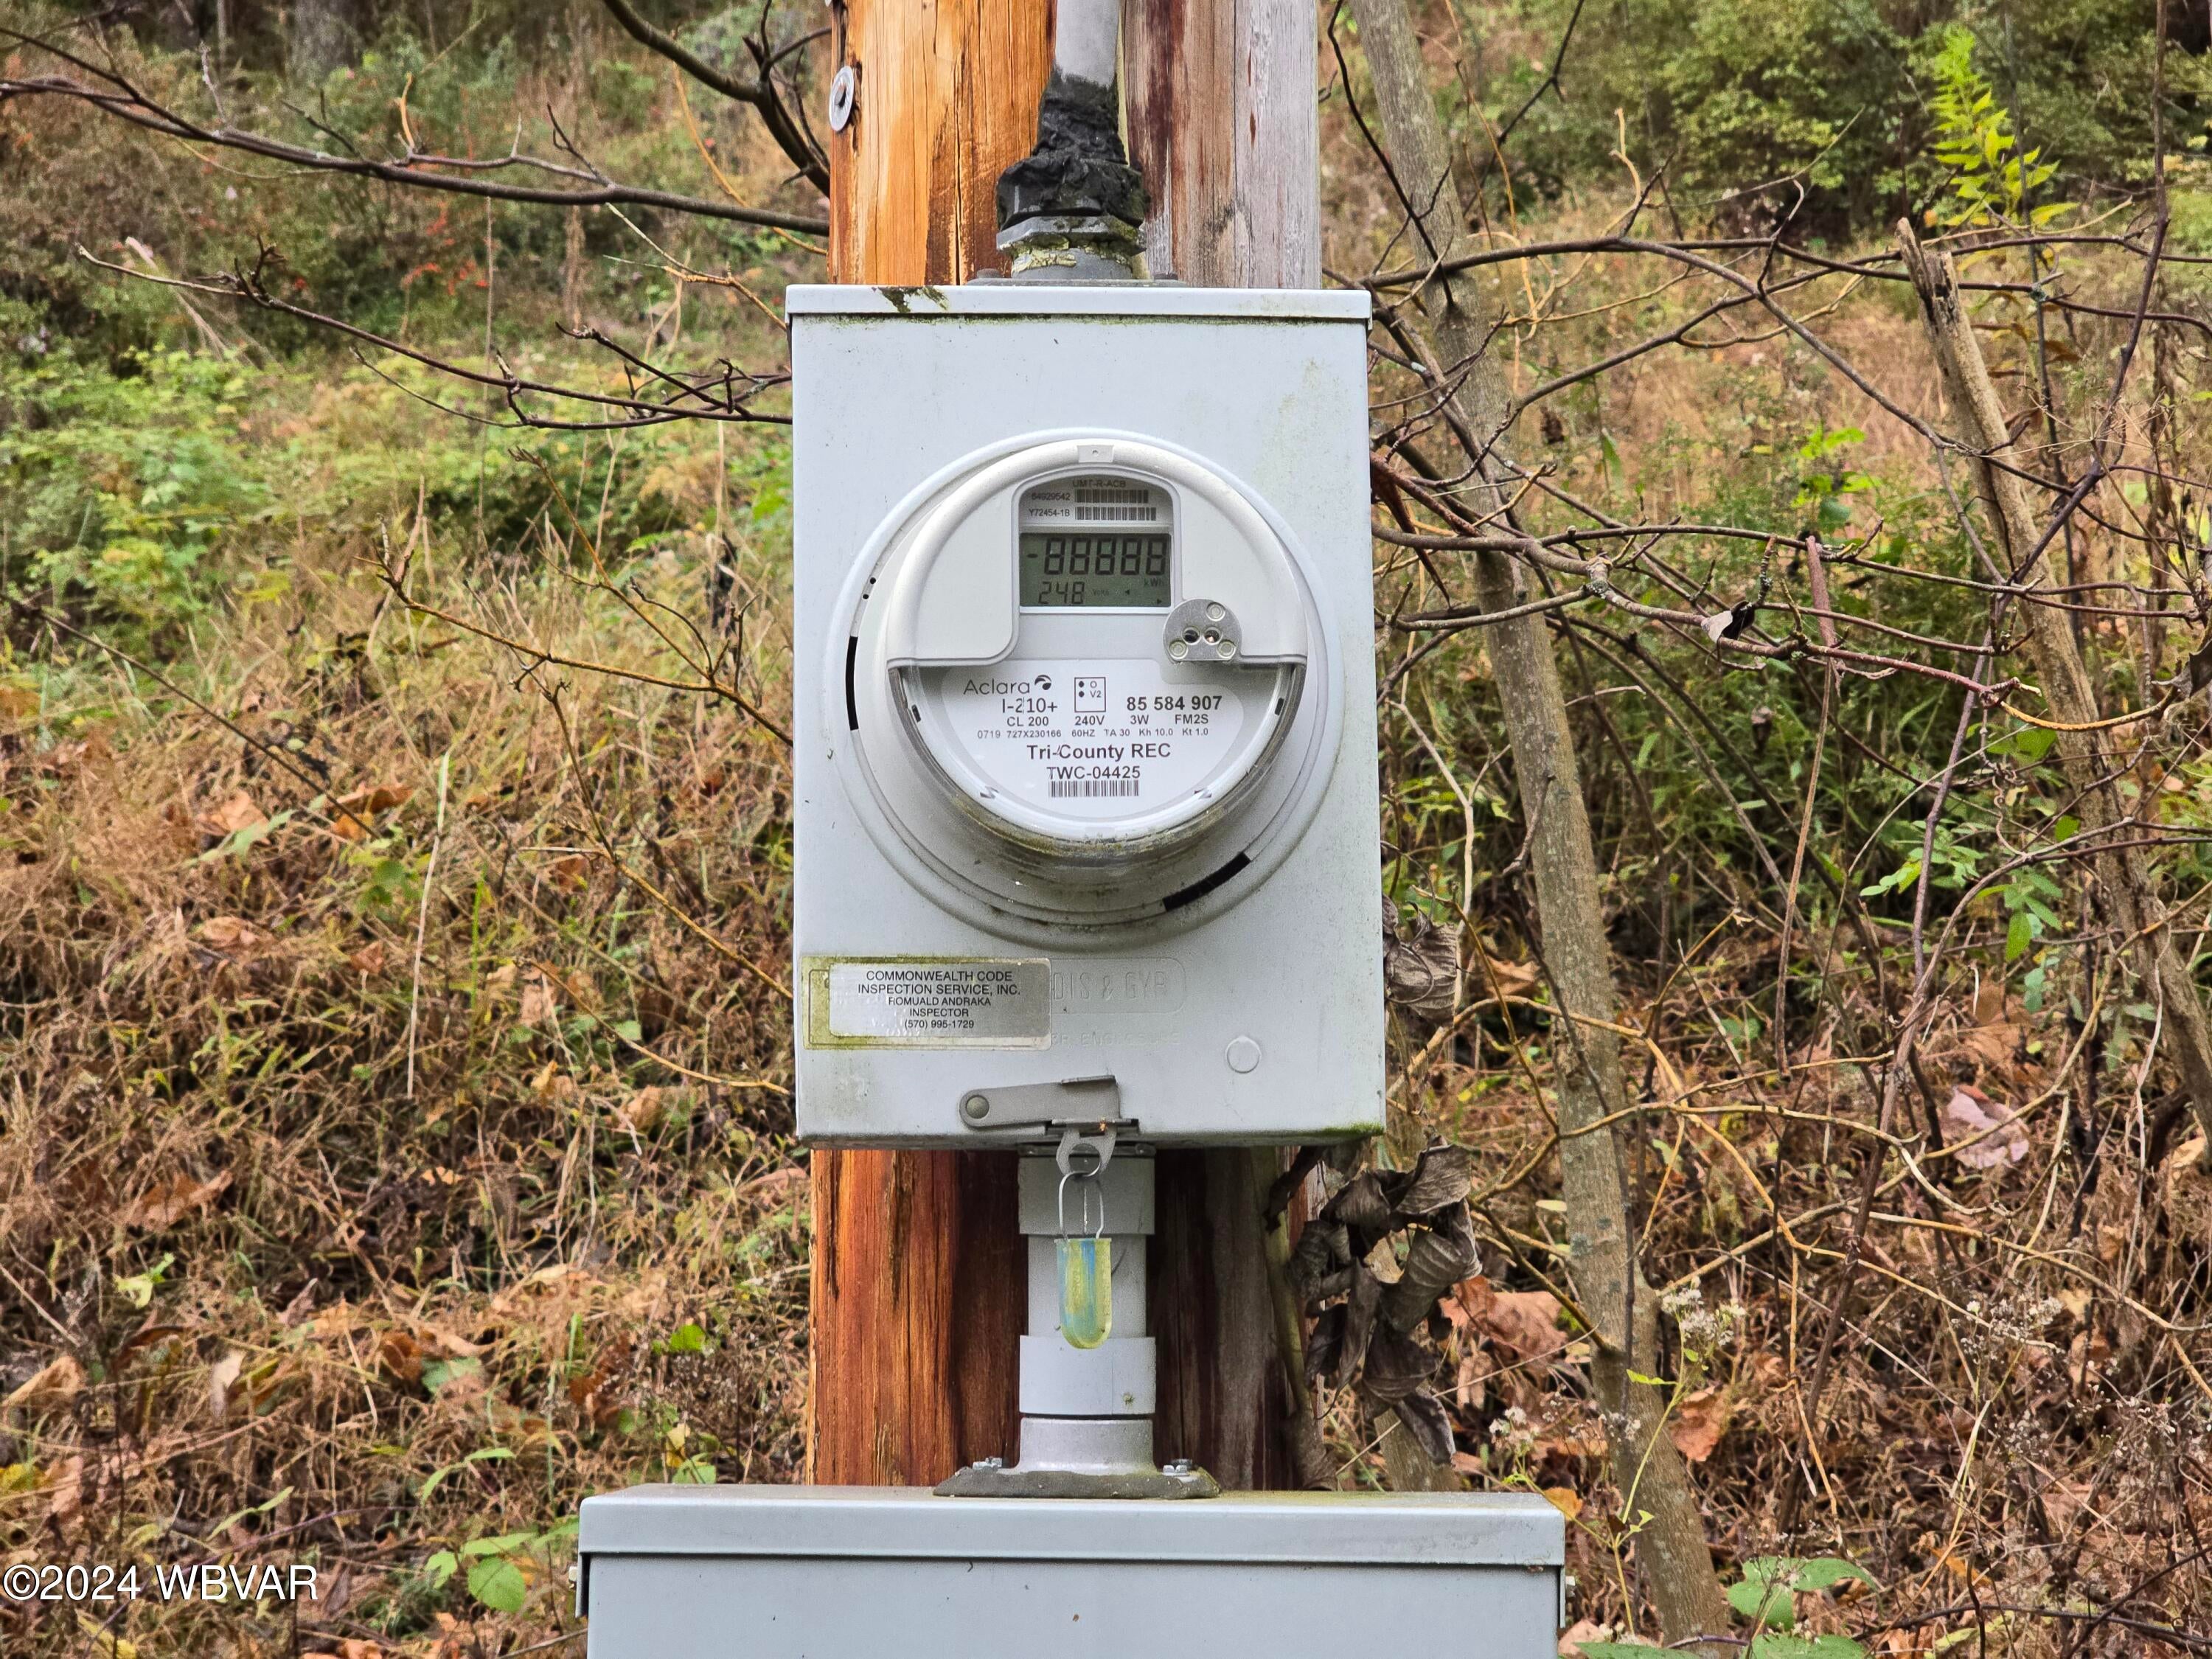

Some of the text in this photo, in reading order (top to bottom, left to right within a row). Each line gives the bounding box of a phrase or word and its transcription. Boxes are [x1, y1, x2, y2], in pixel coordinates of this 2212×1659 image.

[1029, 508, 1071, 517] Y72454-1B
[1038, 581, 1085, 605] 248
[963, 678, 1031, 695] Aclara
[1090, 690, 1102, 698] V2
[1002, 698, 1058, 713] I-210+
[1127, 695, 1222, 711] 85 584 907
[1006, 716, 1049, 727] CL 200
[1074, 714, 1209, 726] 240V 3W FM2S
[977, 730, 1001, 739] 0719
[1006, 730, 1062, 738] 727X230166
[1071, 728, 1096, 737] 60HZ
[1119, 728, 1130, 737] 30
[1138, 728, 1152, 737] Kh
[1155, 728, 1174, 737] 10.0
[1182, 728, 1192, 736] Kt
[1196, 728, 1209, 736] 1.0
[1026, 742, 1171, 762] Tri-County REC
[1047, 765, 1141, 779] TWC-04425
[866, 970, 1013, 981] COMMONWEALTH CODE
[858, 984, 1020, 996] INSPECTION SERVICE, INC.
[888, 997, 991, 1006] ROMUALD ANDRAKA
[909, 1008, 969, 1017] INSPECTOR
[904, 1020, 974, 1029] (570) 995-1729
